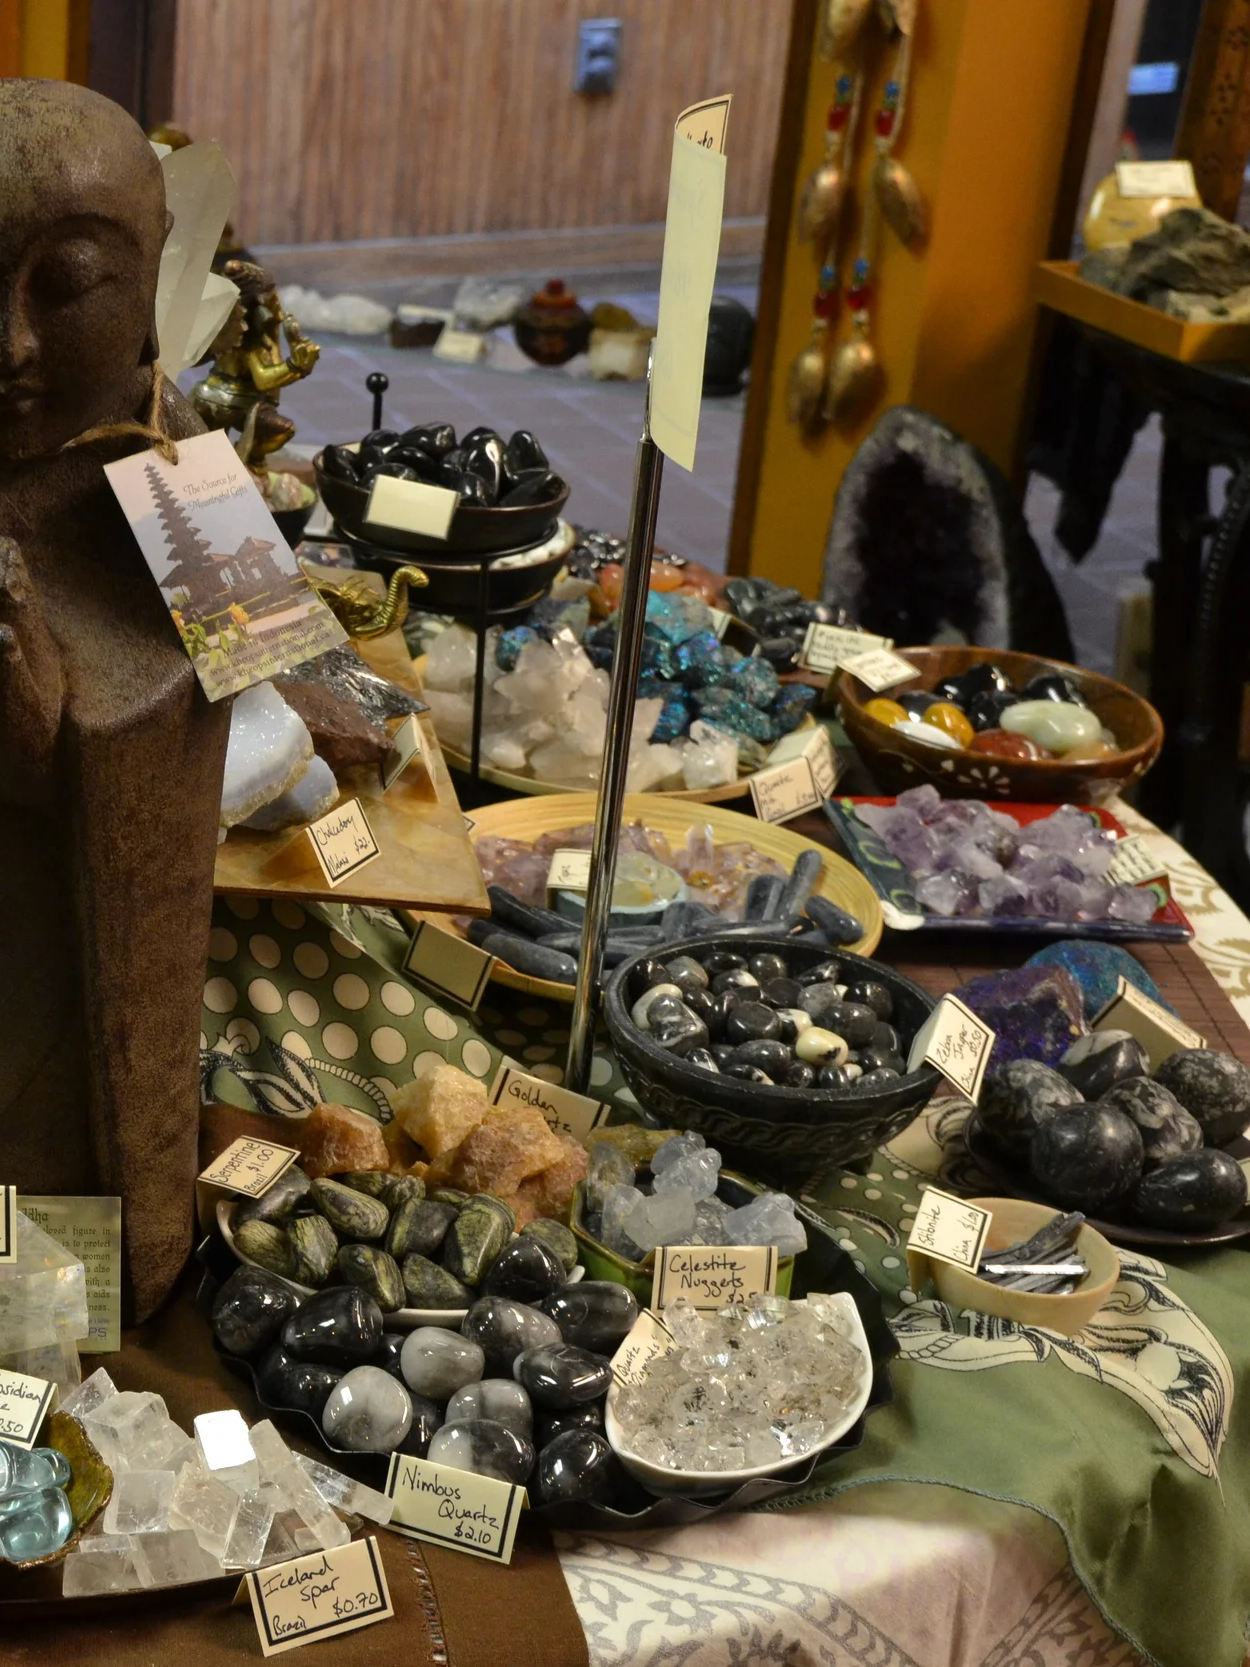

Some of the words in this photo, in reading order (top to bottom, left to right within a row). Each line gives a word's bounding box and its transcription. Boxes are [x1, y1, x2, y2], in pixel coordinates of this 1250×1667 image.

[201, 477, 227, 491] Source
[258, 619, 303, 644] Indonesia
[507, 1079, 558, 1115] Golden
[210, 1141, 262, 1184] Serpentine
[72, 1225, 97, 1236] figure
[102, 1225, 111, 1235] in
[73, 1239, 81, 1248] to
[83, 1241, 111, 1250] protect
[93, 1263, 111, 1273] also
[669, 1253, 746, 1273] Celestite
[93, 1289, 111, 1299] aids
[402, 1465, 461, 1500] Nimbus
[438, 1498, 500, 1530] Quartz
[454, 1520, 492, 1544] $2.10
[263, 1555, 334, 1598] Iceland
[332, 1592, 378, 1618] $0.70
[272, 1615, 307, 1636] Brazil
